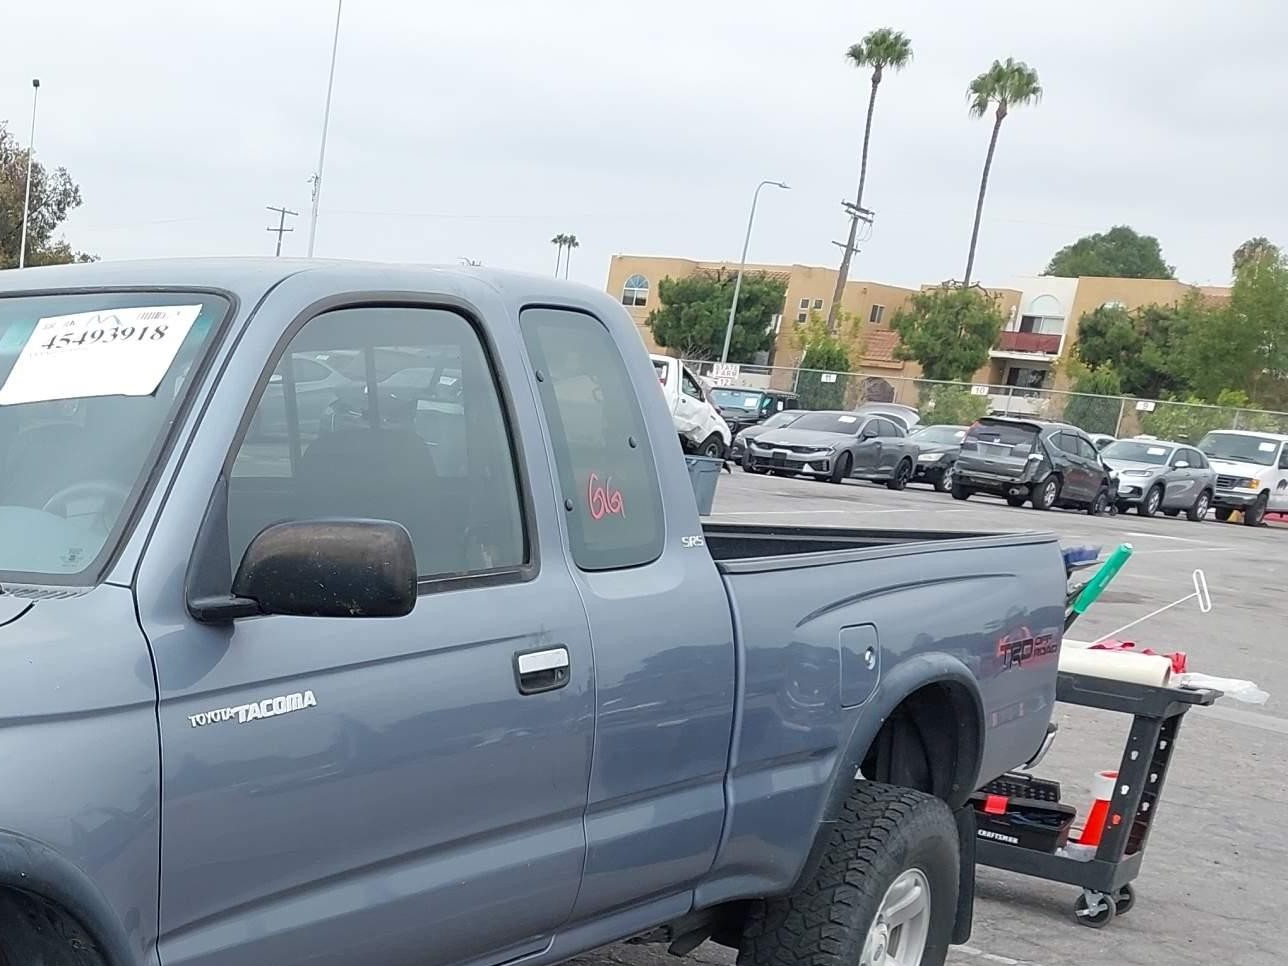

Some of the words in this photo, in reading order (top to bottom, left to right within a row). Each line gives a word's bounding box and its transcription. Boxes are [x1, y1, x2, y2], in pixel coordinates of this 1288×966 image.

[41, 325, 169, 350] 45493918
[1143, 402, 1149, 410] 9
[1034, 633, 1053, 646] OFF
[999, 637, 1034, 670] TRD
[1034, 644, 1058, 657] ROAD
[188, 707, 234, 728] TOYOTA
[232, 690, 318, 724] TACOMA
[977, 829, 1019, 844] CRAFTSMAN
